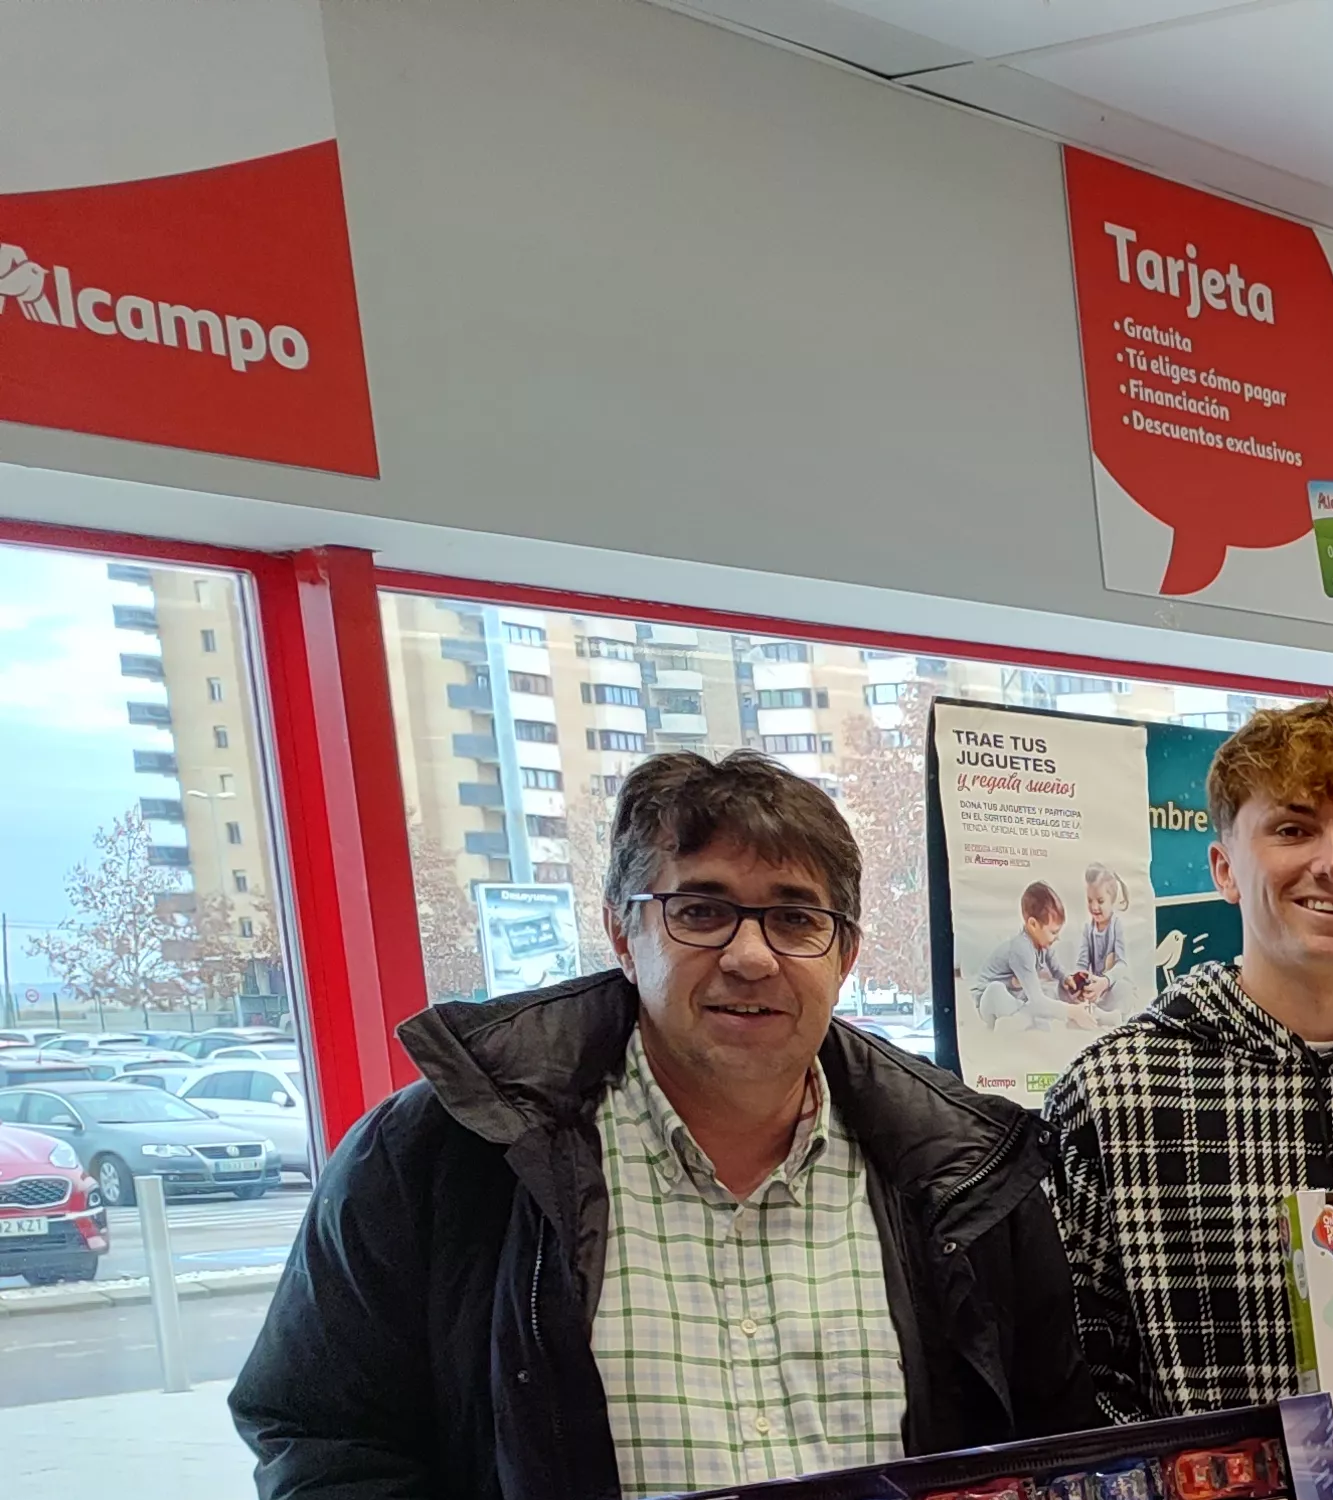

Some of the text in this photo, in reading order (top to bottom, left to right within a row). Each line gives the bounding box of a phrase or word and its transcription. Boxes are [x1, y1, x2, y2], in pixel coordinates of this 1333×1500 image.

[1103, 221, 1275, 325] Tarjeta
[1123, 316, 1193, 353] Gratuita
[1125, 348, 1288, 407] Tú eliges cómo pagar
[1129, 378, 1231, 422] Financiación
[1132, 409, 1303, 467] Descuentos exclusivos
[952, 729, 1047, 754] TRAE TUS
[956, 750, 1056, 774] JUGUETES
[957, 772, 1076, 798] y regala sueños
[960, 800, 982, 810] DONA
[999, 804, 1037, 815] JUGUETES
[1044, 807, 1082, 818] PARTICIPA
[961, 811, 972, 820] EN
[973, 812, 983, 821] EL
[984, 813, 1013, 824] SORTEO
[1026, 818, 1061, 828] REGALOS
[962, 823, 988, 833] TIENDA
[991, 825, 1018, 836] OFICIAL
[976, 1075, 1016, 1090] Alcampo
